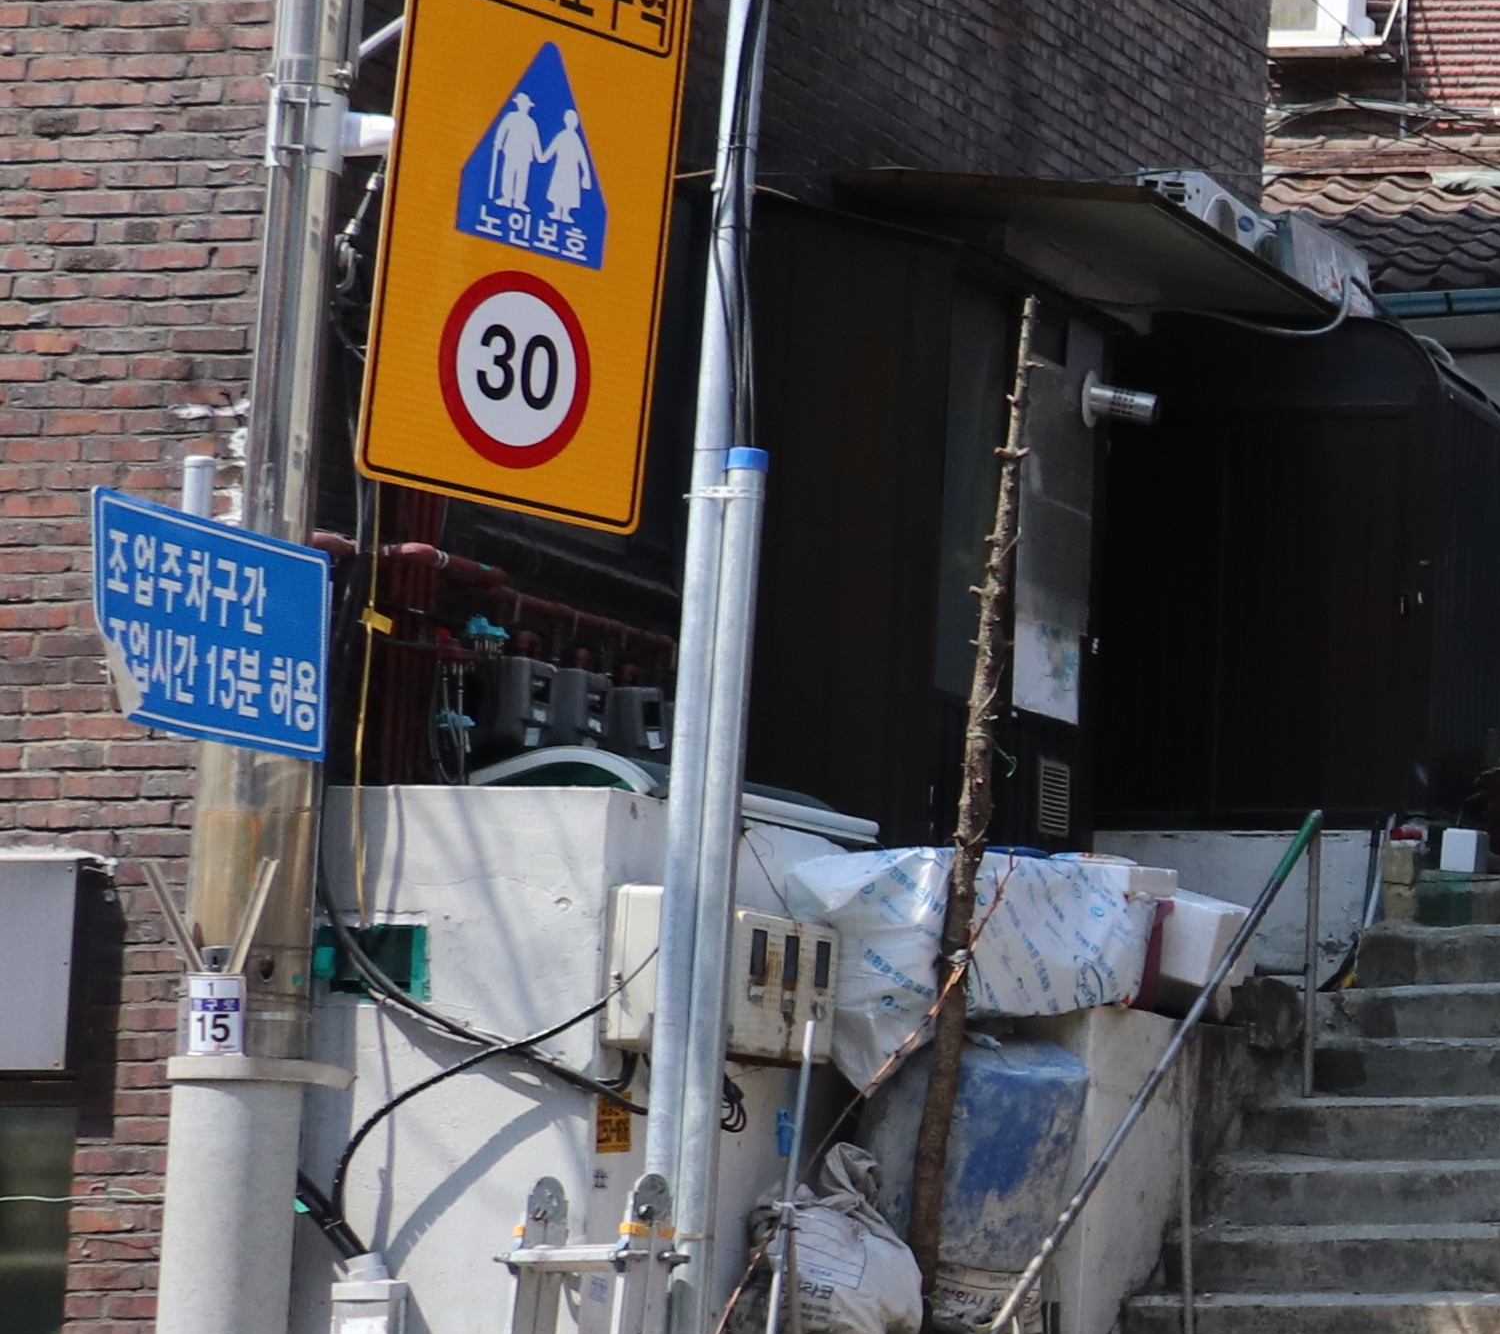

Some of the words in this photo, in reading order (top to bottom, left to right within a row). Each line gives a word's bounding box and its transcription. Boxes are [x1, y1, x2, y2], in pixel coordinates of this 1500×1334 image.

[475, 205, 588, 261] 노인보호
[476, 324, 559, 411] 30
[107, 529, 267, 635] 조업주차구간
[206, 644, 262, 718] 15분
[269, 657, 318, 732] 허용
[207, 981, 214, 996] 1
[196, 1013, 230, 1043] 15
